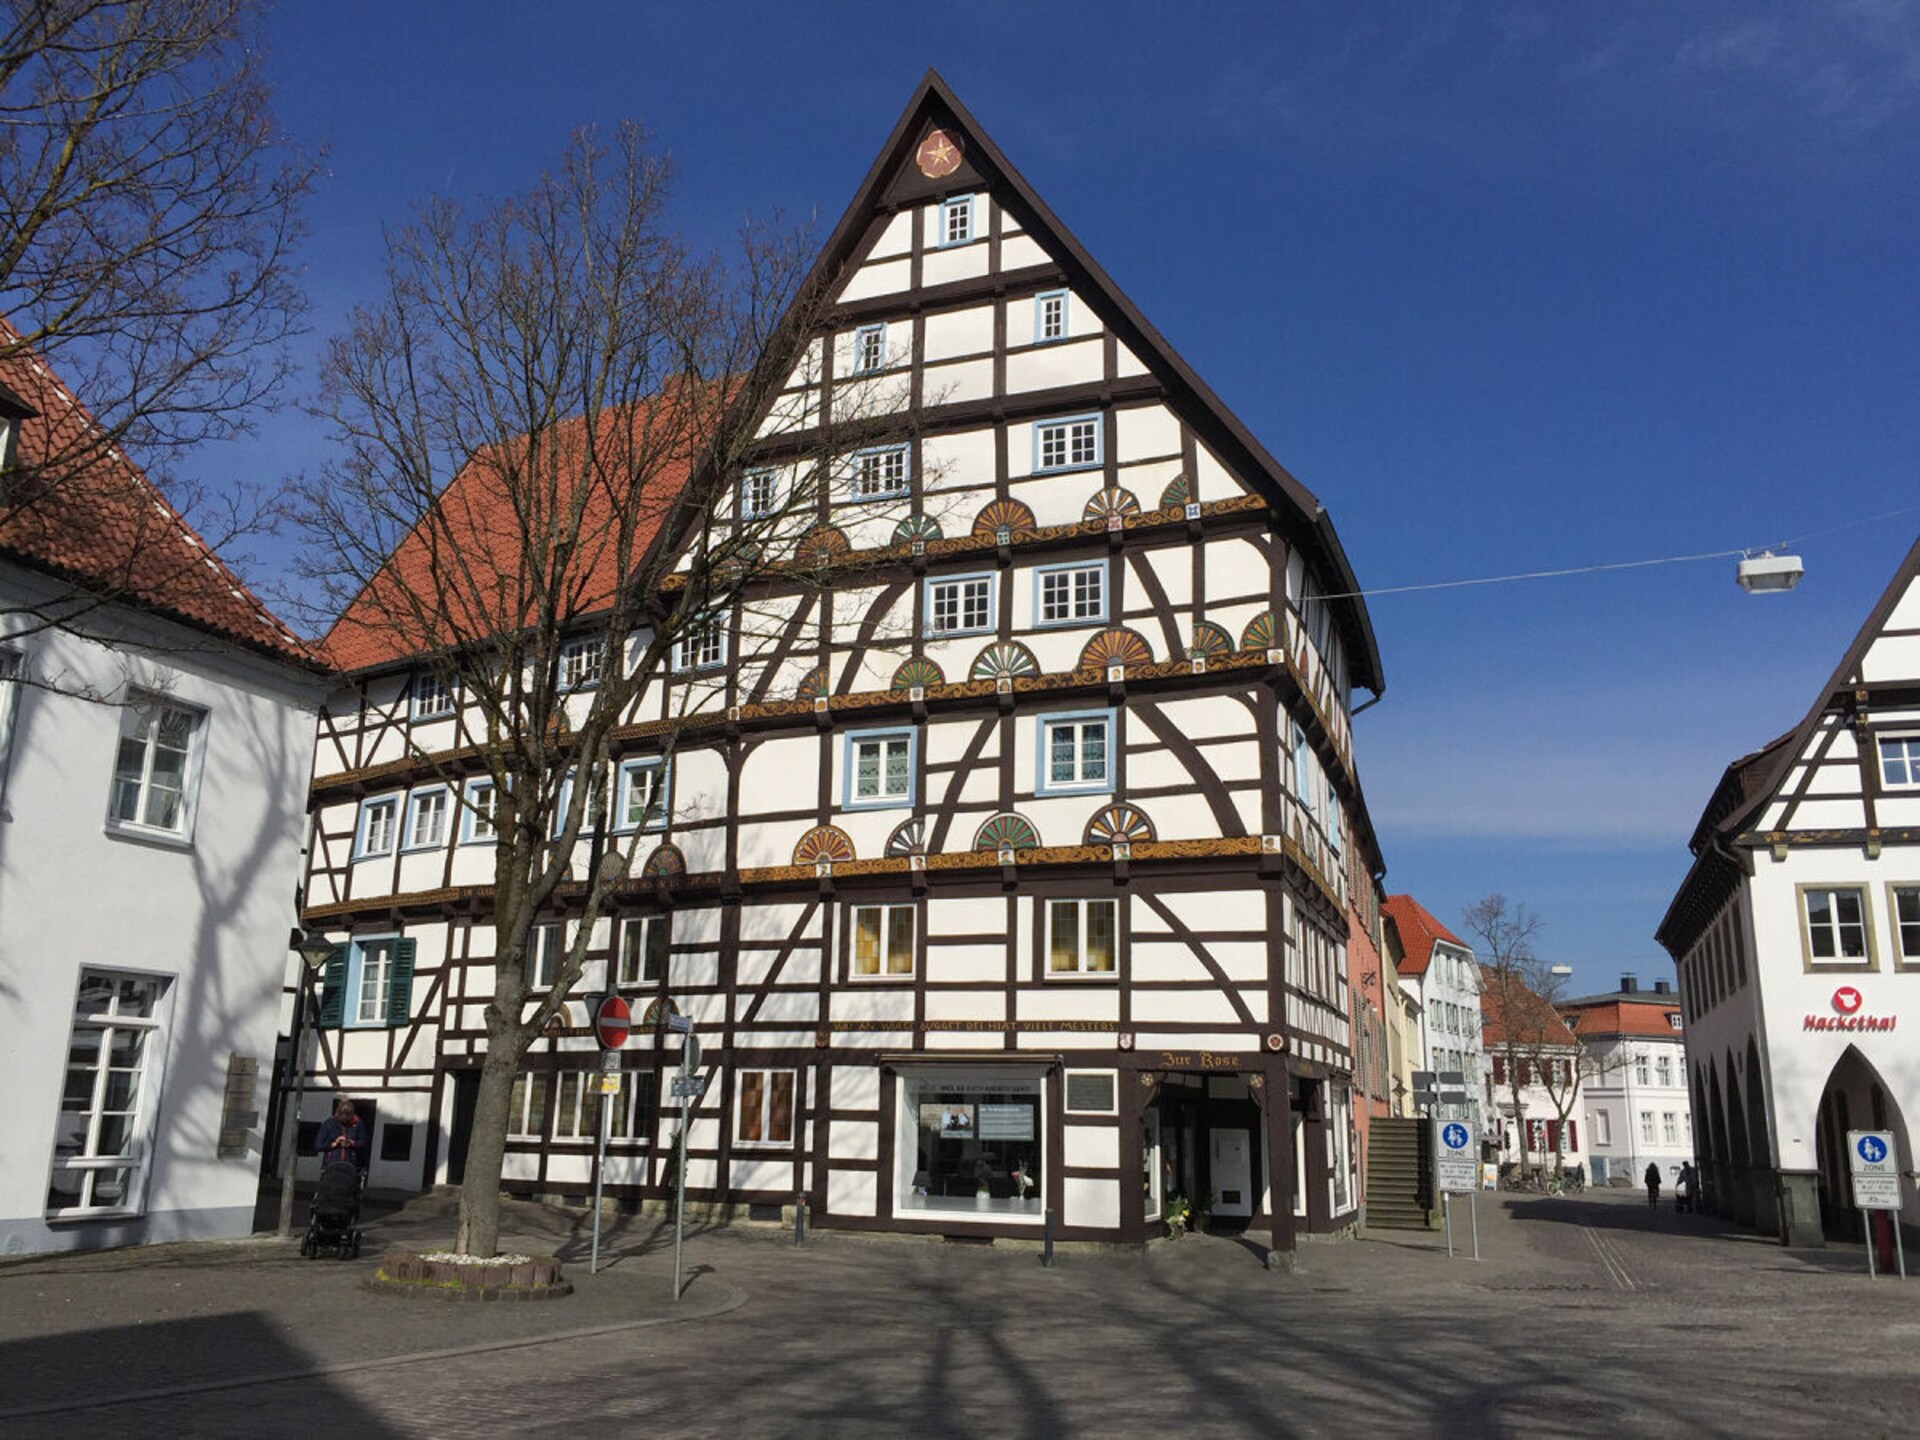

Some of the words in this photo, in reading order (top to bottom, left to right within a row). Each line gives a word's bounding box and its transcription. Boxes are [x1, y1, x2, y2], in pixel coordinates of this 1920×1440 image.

[1803, 1015, 1896, 1032] Hackethal
[1160, 1051, 1191, 1068] Zur
[1200, 1051, 1240, 1069] Rose
